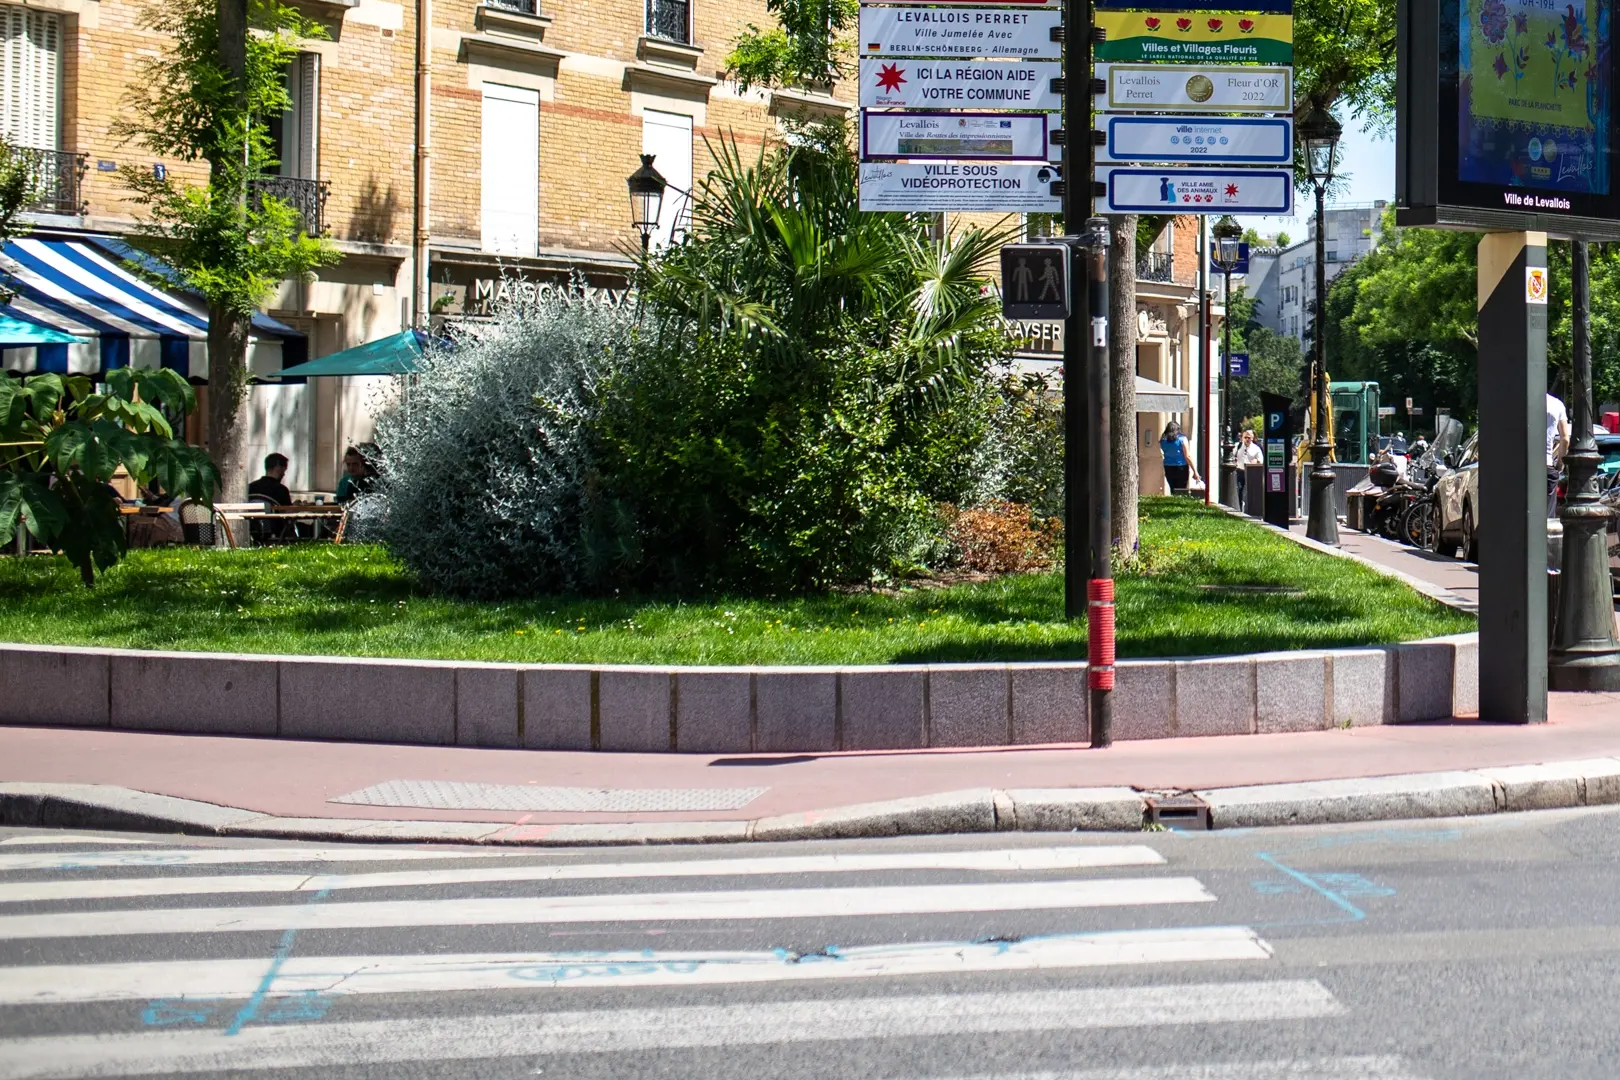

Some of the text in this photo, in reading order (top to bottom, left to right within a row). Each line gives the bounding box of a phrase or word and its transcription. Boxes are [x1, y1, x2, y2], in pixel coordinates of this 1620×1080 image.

[897, 11, 1028, 25] LEVALLOIS PERRET
[914, 28, 1013, 39] Ville Jumelée Avec
[992, 46, 1039, 55] Allemagne
[1141, 42, 1257, 55] Villes et Villages Fleuris
[917, 66, 1036, 81] ICI LA RÉGION AIDE
[1119, 75, 1161, 85] Levallois
[1227, 78, 1252, 88] Fleur
[922, 88, 1031, 100] VOTRE COMMUNE
[1126, 89, 1153, 99] Perret
[1242, 92, 1265, 101] 2022
[899, 119, 939, 129] Levallois
[1176, 125, 1222, 134] ville internet
[1190, 146, 1208, 154] 2022
[924, 165, 998, 176] VILLE SOUS
[901, 176, 1021, 189] VIDÉOPROTECTION
[1504, 192, 1570, 210] Ville de Levallois
[475, 278, 571, 308] MAISON
[1270, 413, 1280, 428] P
